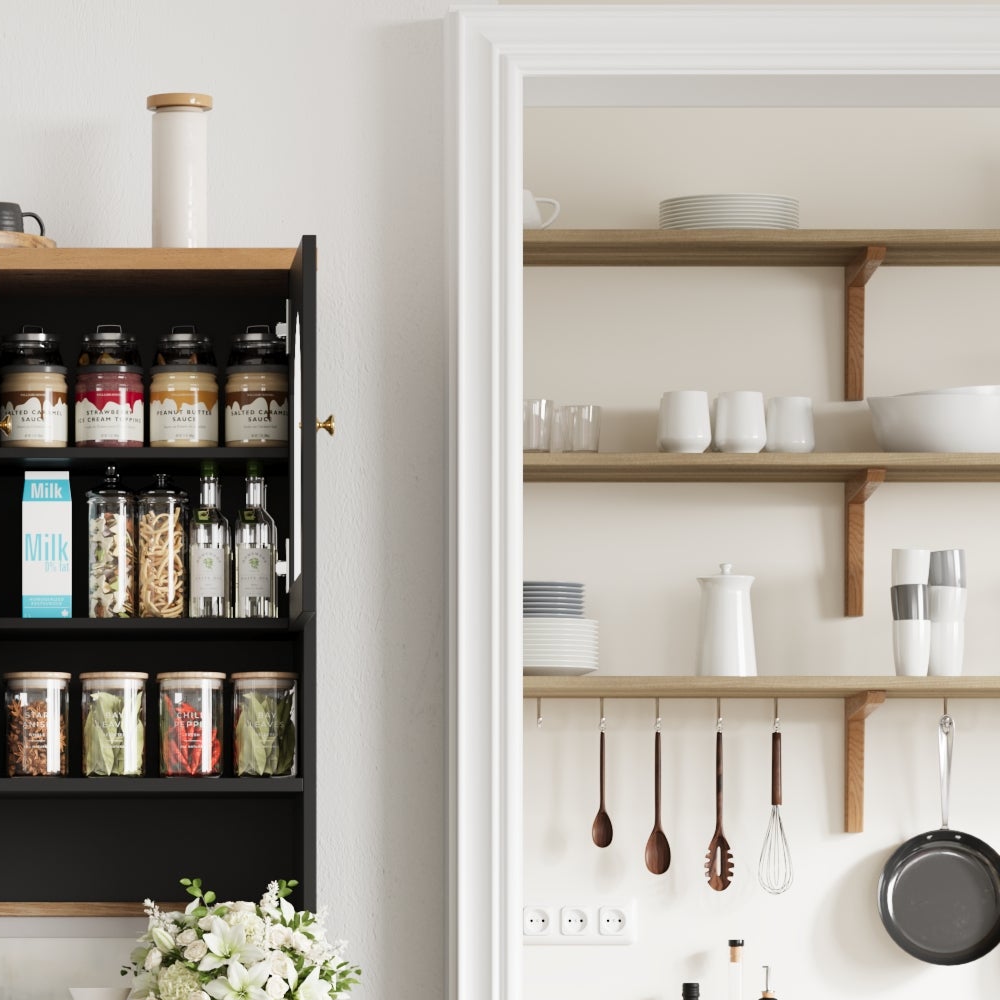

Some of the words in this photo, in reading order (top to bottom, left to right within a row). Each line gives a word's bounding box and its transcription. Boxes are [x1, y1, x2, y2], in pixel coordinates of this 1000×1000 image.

[30, 482, 63, 499] Milk
[24, 533, 69, 562] Milk
[44, 562, 57, 573] 0%
[59, 562, 69, 573] fat
[176, 711, 203, 719] CHIL
